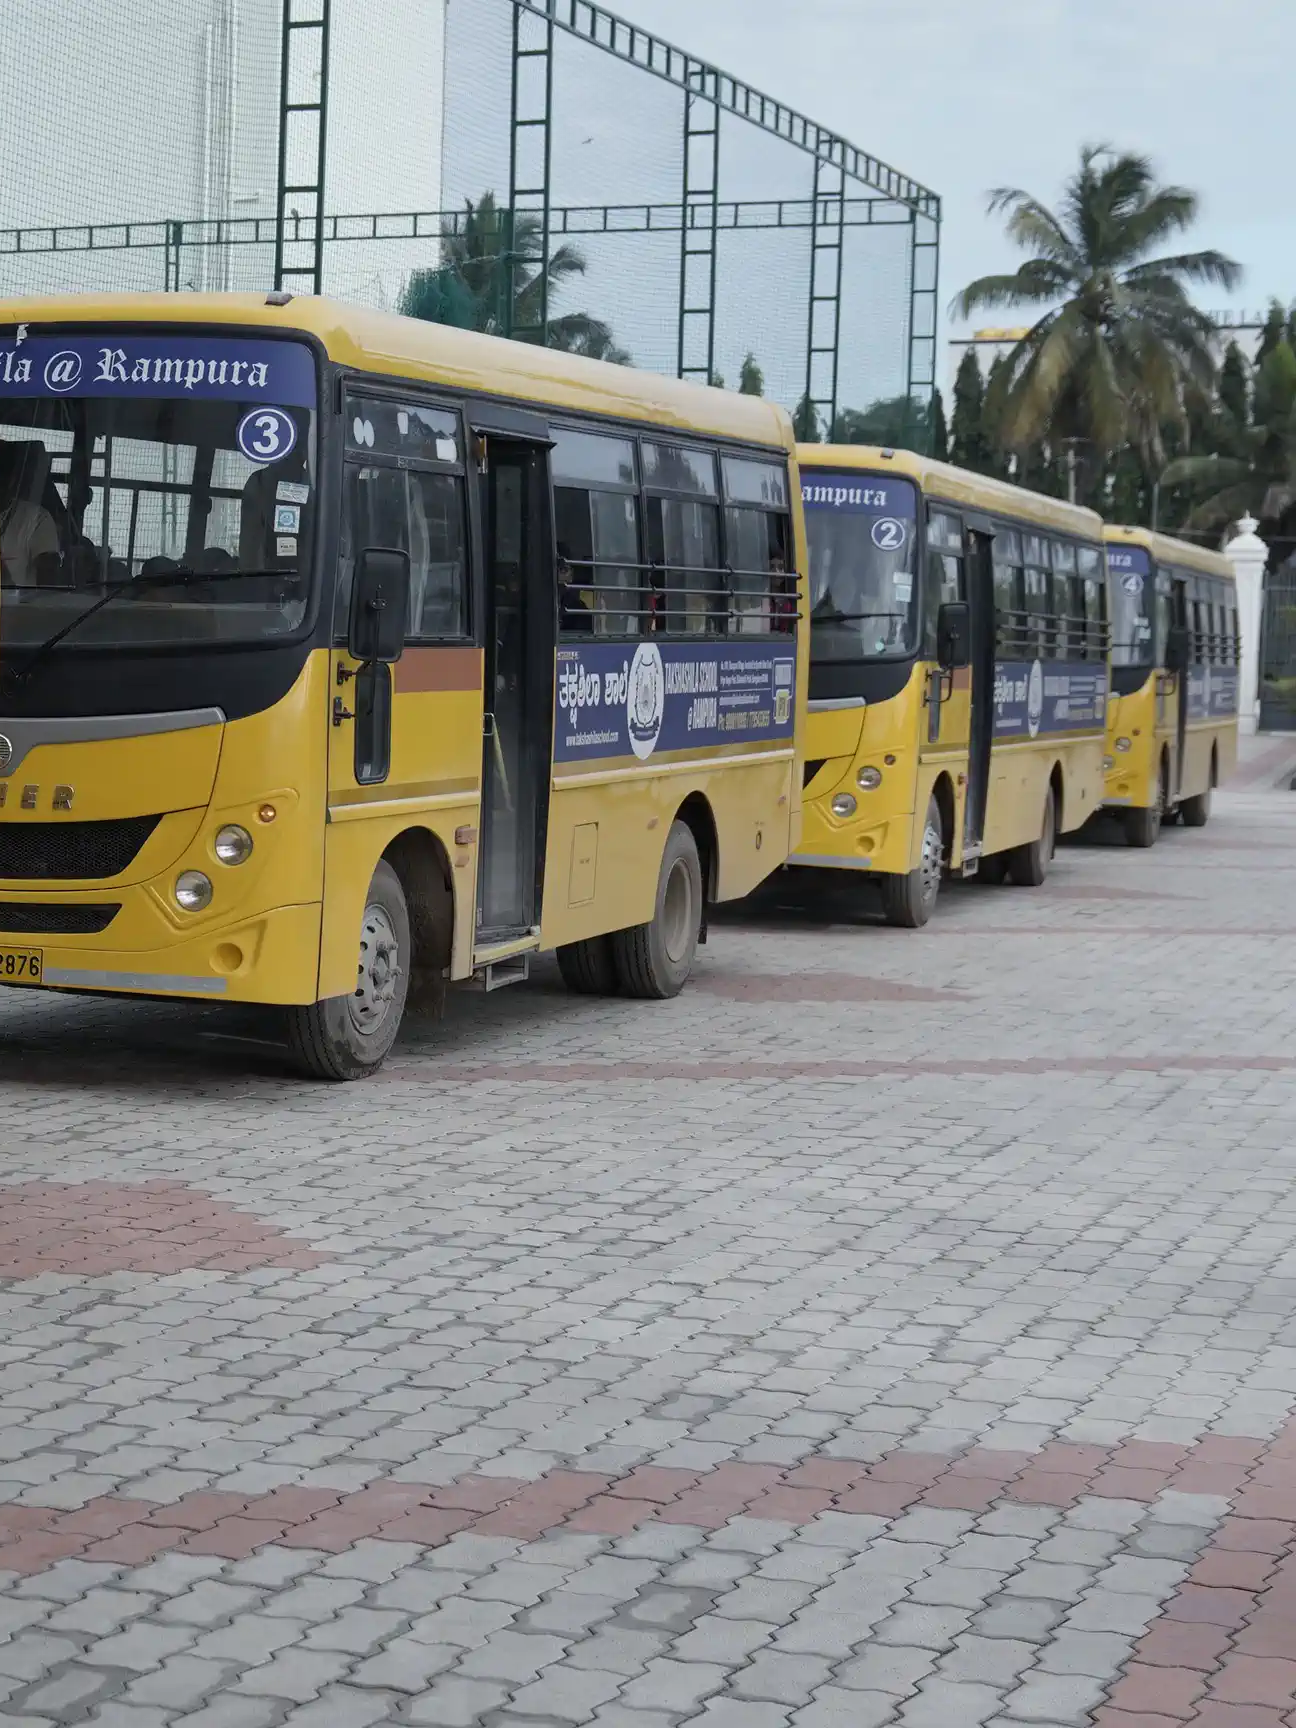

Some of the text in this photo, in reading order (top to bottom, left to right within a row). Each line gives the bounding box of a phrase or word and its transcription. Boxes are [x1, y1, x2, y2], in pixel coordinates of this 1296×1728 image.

[44, 350, 82, 392] @
[93, 348, 269, 390] Rampura
[252, 415, 280, 454] 3
[880, 521, 897, 546] 2
[1123, 576, 1141, 591] 4
